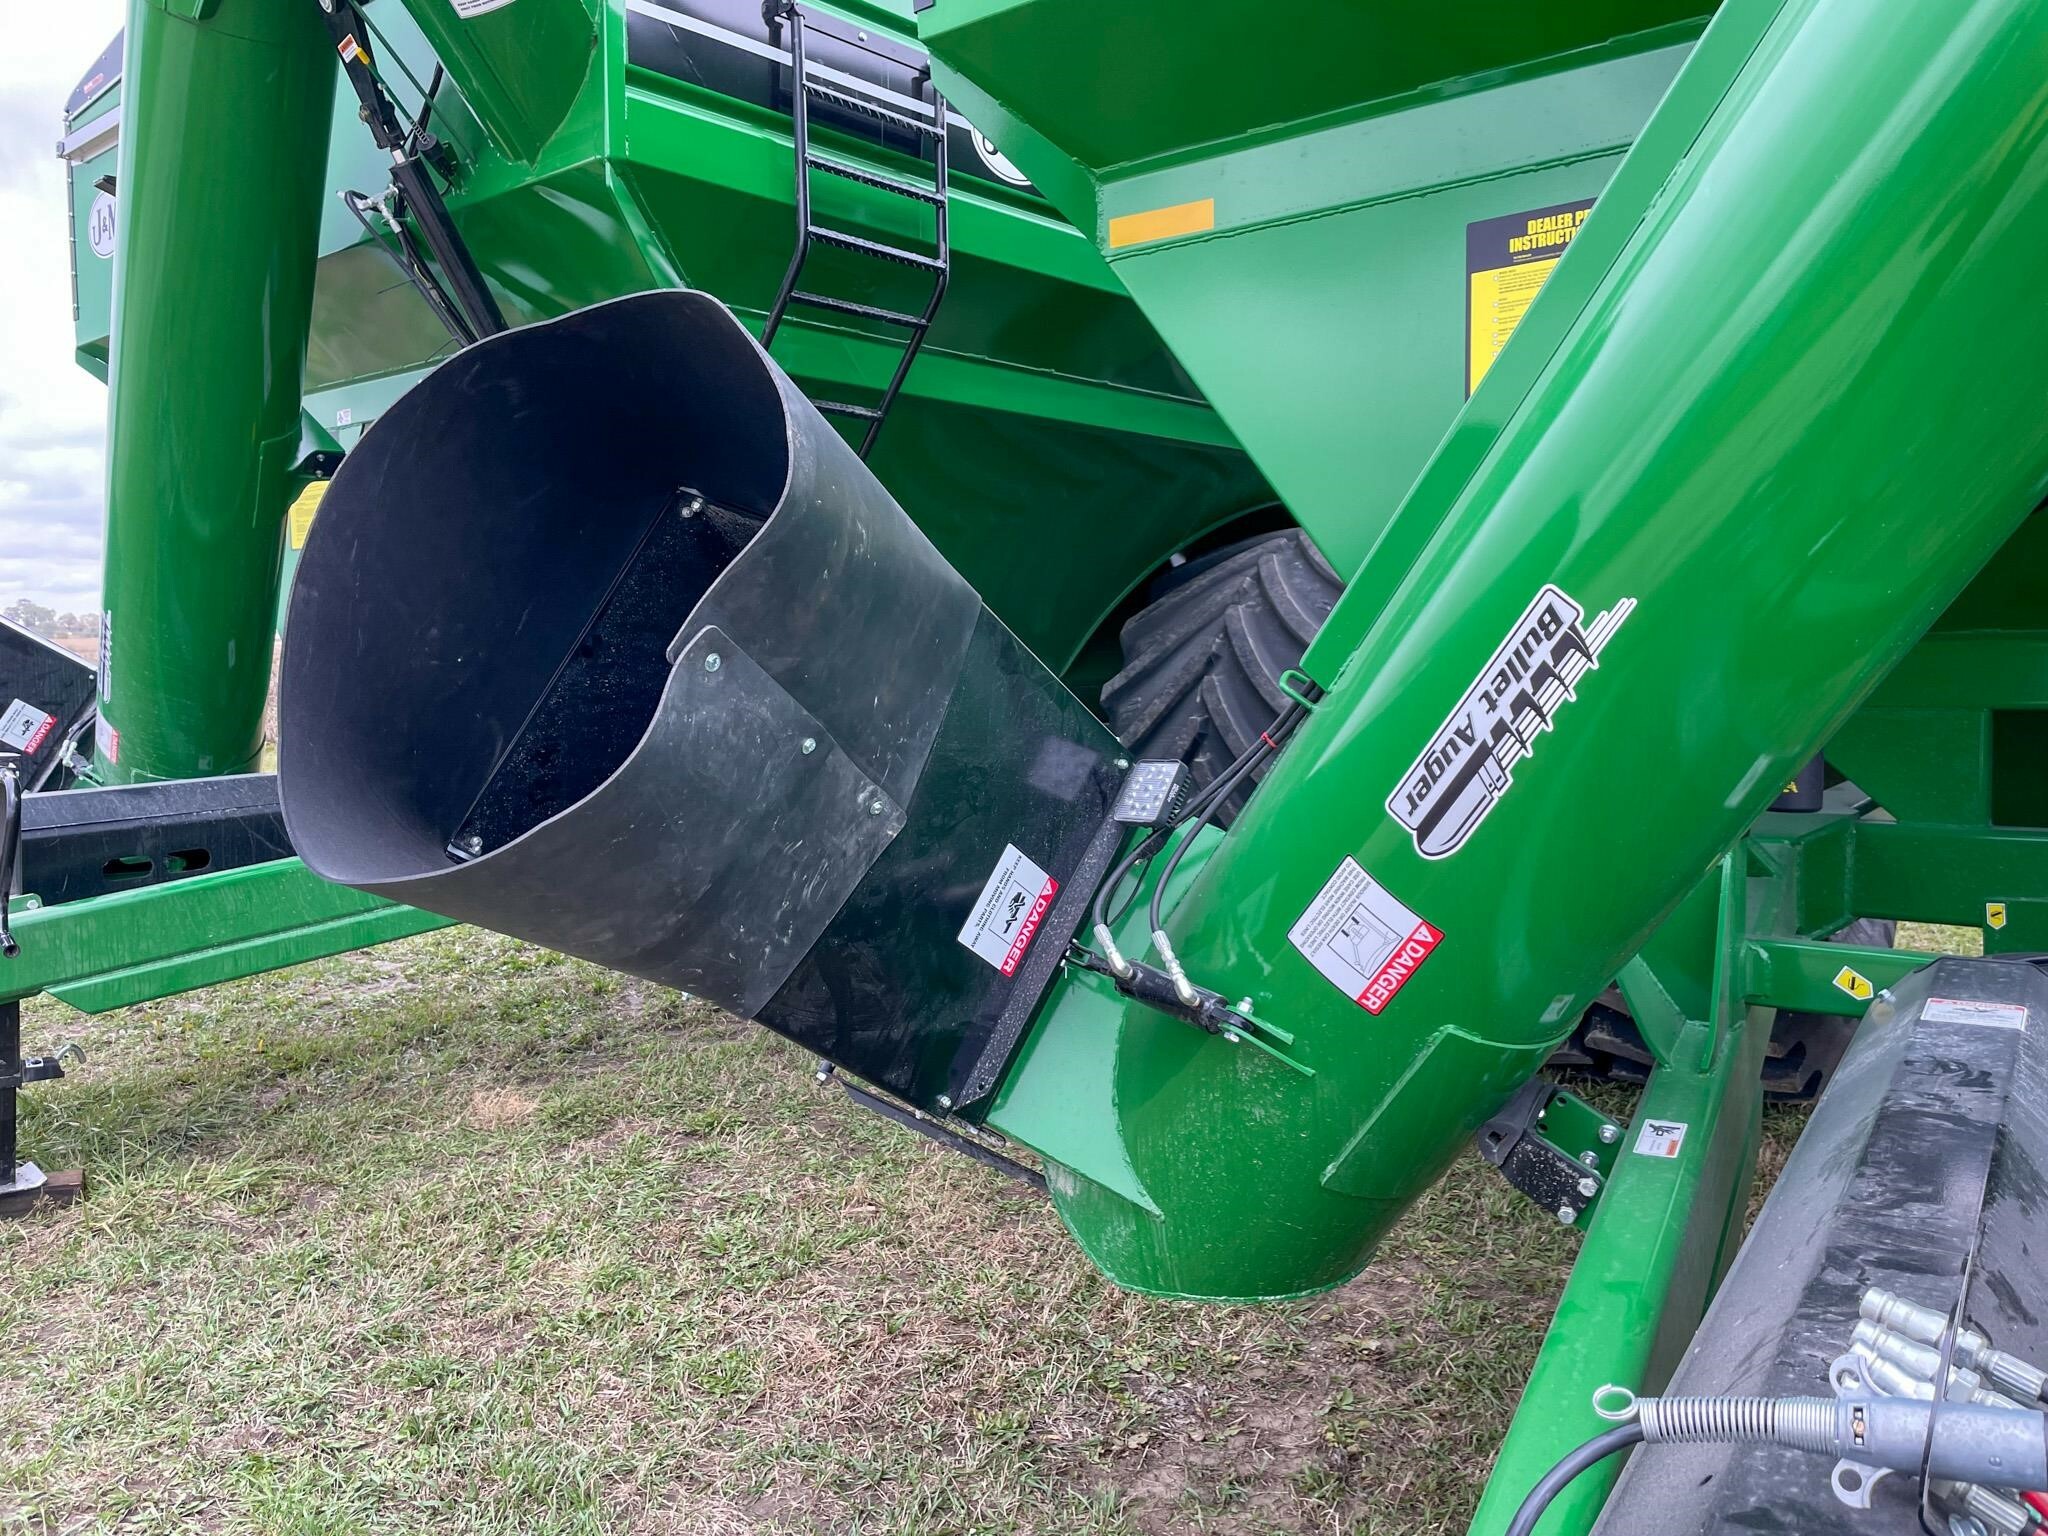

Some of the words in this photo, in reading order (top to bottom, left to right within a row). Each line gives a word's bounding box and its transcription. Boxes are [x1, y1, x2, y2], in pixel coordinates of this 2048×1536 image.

[1527, 213, 1573, 235] DEALER
[1478, 601, 1564, 714] Bullet
[26, 721, 51, 753] DANGER
[1405, 711, 1477, 817] Auger
[1011, 854, 1022, 870] KEEP
[998, 867, 1009, 884] FROM
[1001, 869, 1014, 890] HANDS
[985, 884, 999, 908] MOVING
[994, 889, 1003, 903] AND
[979, 903, 996, 931] CLOTHING
[970, 931, 981, 948] AWAY
[1003, 899, 1046, 972] DANGER
[1361, 940, 1425, 1010] DANGER
